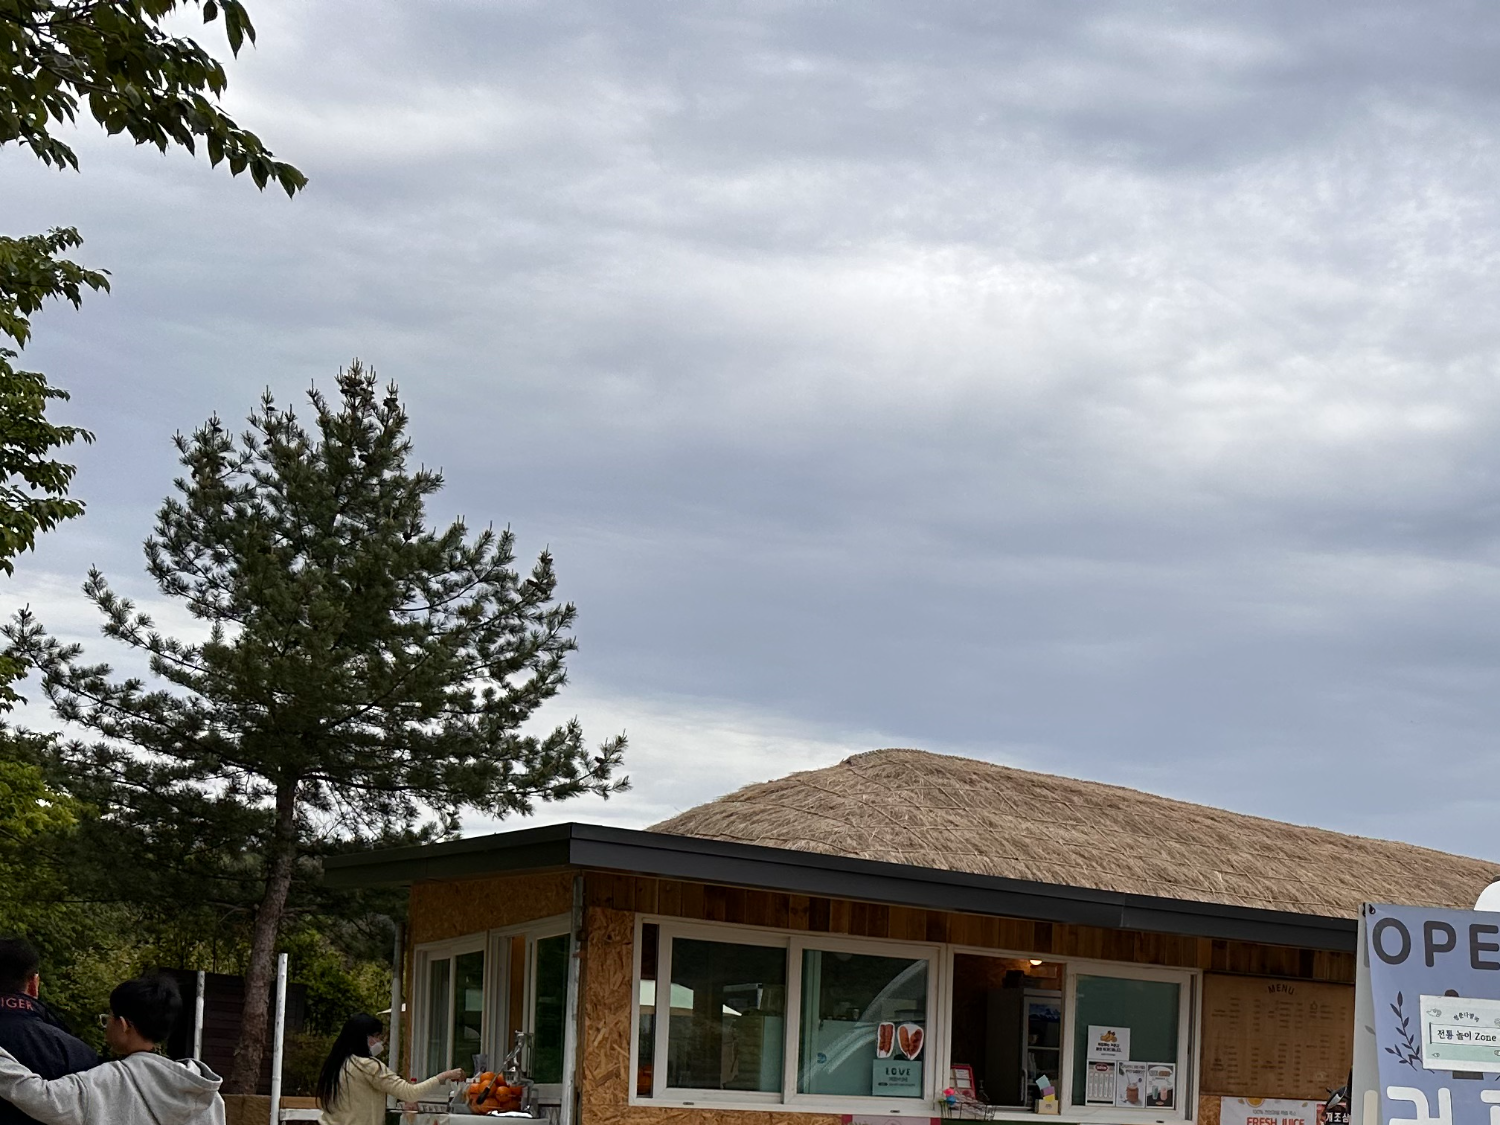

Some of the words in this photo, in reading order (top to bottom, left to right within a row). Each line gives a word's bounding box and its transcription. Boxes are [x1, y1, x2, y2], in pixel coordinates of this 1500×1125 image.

[1268, 983, 1295, 995] MENU
[1437, 1029, 1454, 1040] 전통
[1474, 1032, 1497, 1042] Zone
[885, 1067, 911, 1076] LOVE
